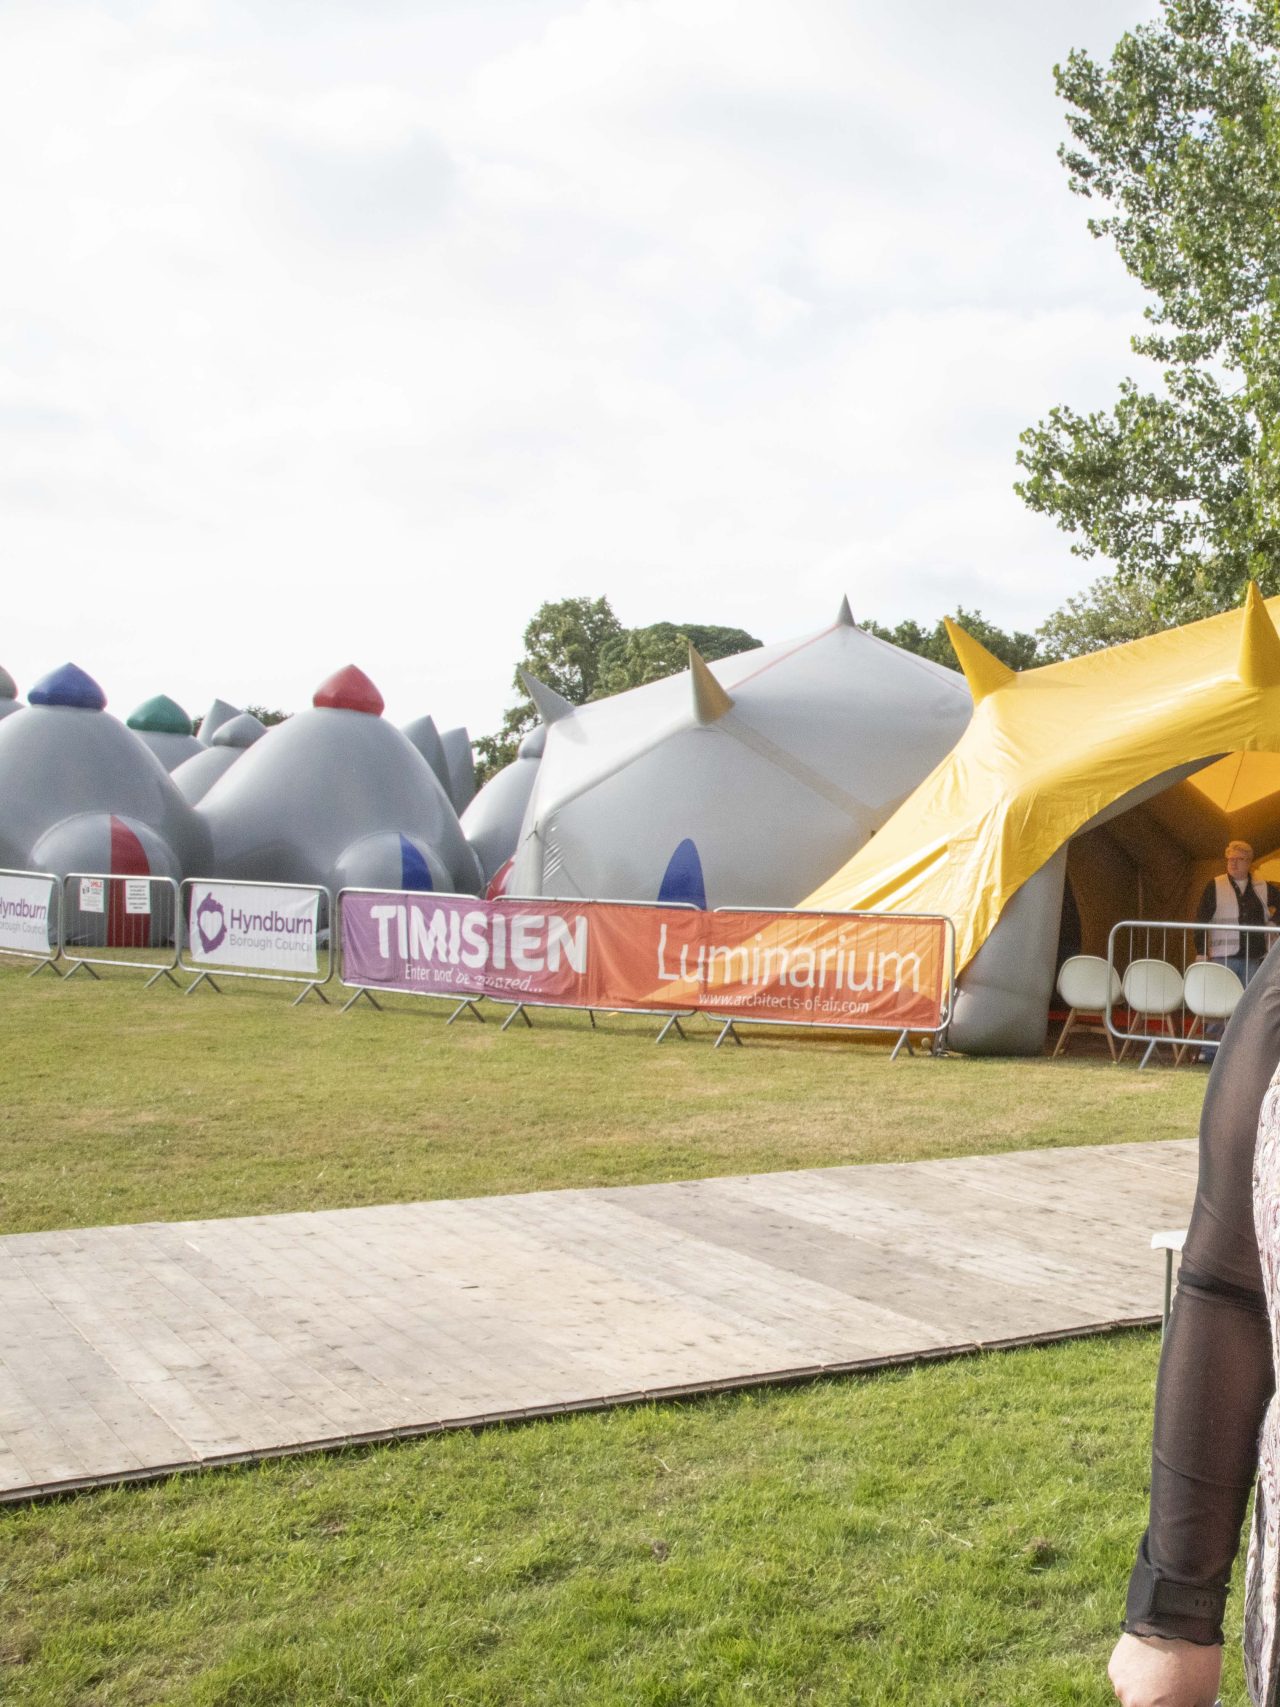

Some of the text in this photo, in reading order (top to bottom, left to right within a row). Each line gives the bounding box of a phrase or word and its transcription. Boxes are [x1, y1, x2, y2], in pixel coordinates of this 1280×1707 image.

[230, 908, 313, 934] Hyndburn
[229, 934, 313, 952] Borough Council
[370, 905, 588, 974] TIMISIEN
[657, 923, 921, 993] Luminarium
[405, 963, 430, 981] Enter
[434, 967, 453, 983] and
[698, 992, 869, 1014] www.architects-of-air.com
